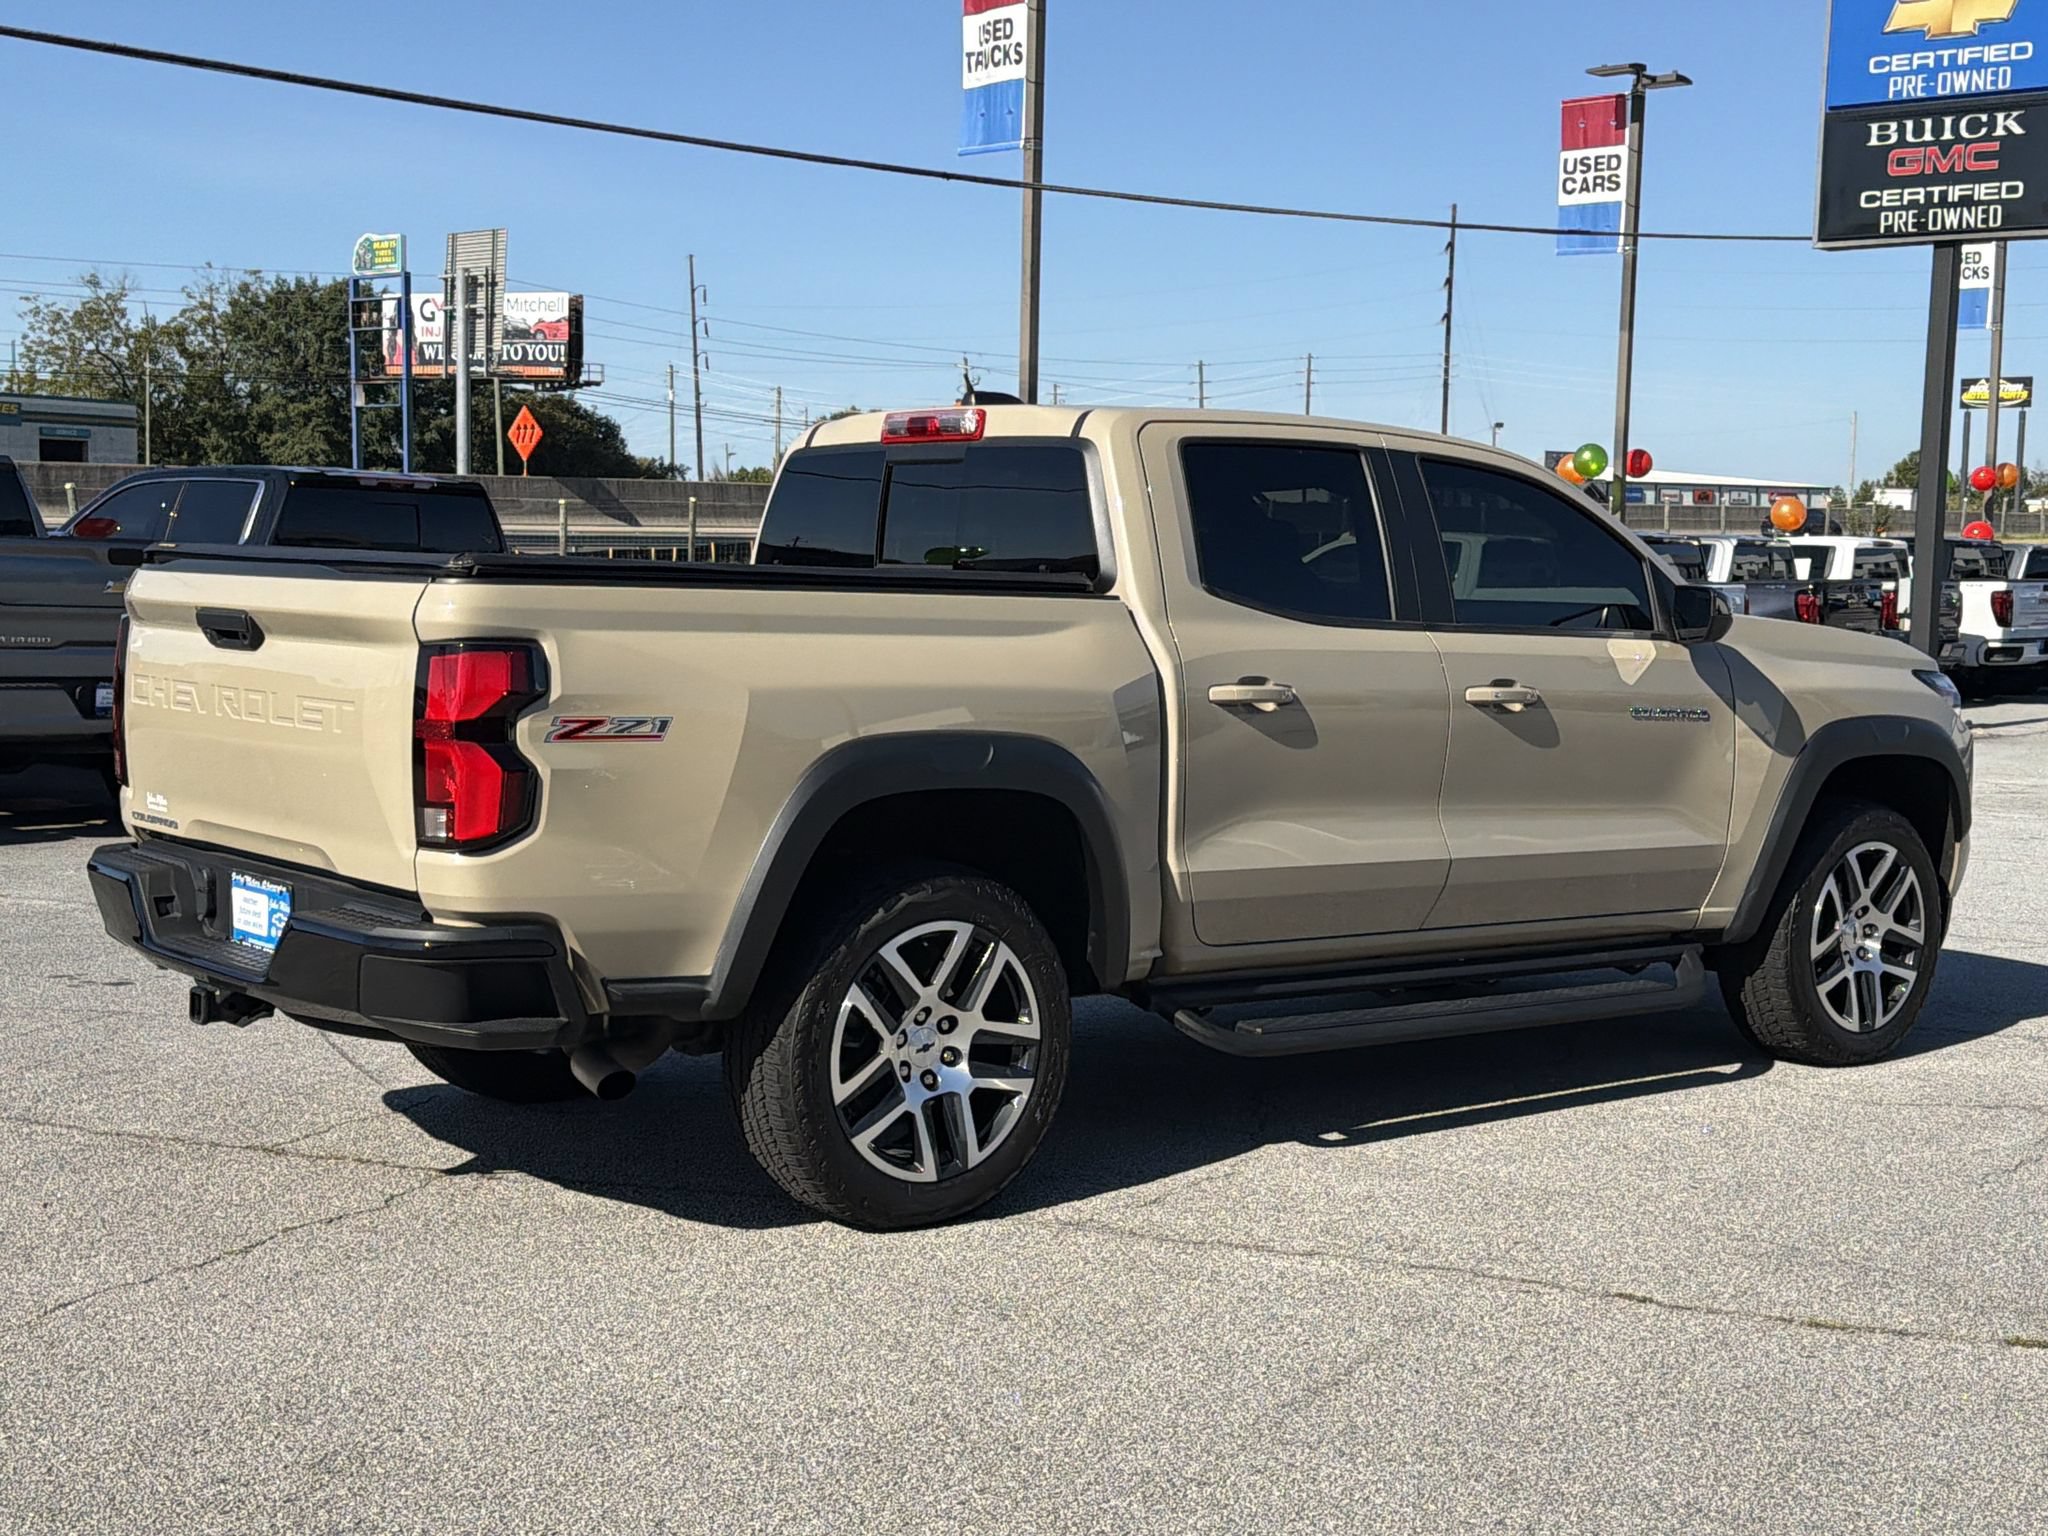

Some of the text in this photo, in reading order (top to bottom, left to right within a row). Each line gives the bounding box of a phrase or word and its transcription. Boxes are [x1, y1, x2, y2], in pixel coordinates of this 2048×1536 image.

[979, 18, 1014, 47] USED
[965, 42, 1024, 73] TRUCKS
[1868, 41, 2033, 74] CERTIFIED
[1888, 66, 2012, 99] PRE-OWNED
[1866, 109, 2026, 146] BUICK
[1562, 153, 1622, 175] USED
[1887, 141, 2000, 177] GMC
[1561, 173, 1621, 195] CARS
[1860, 181, 2024, 208] CERTIFIED
[1880, 205, 2002, 234] PRE-OWNED
[1961, 251, 1982, 265] ED
[506, 297, 564, 313] Mitchell
[526, 343, 566, 361] YOU!
[131, 673, 355, 734] CHEVROLET
[544, 716, 674, 743] Z71
